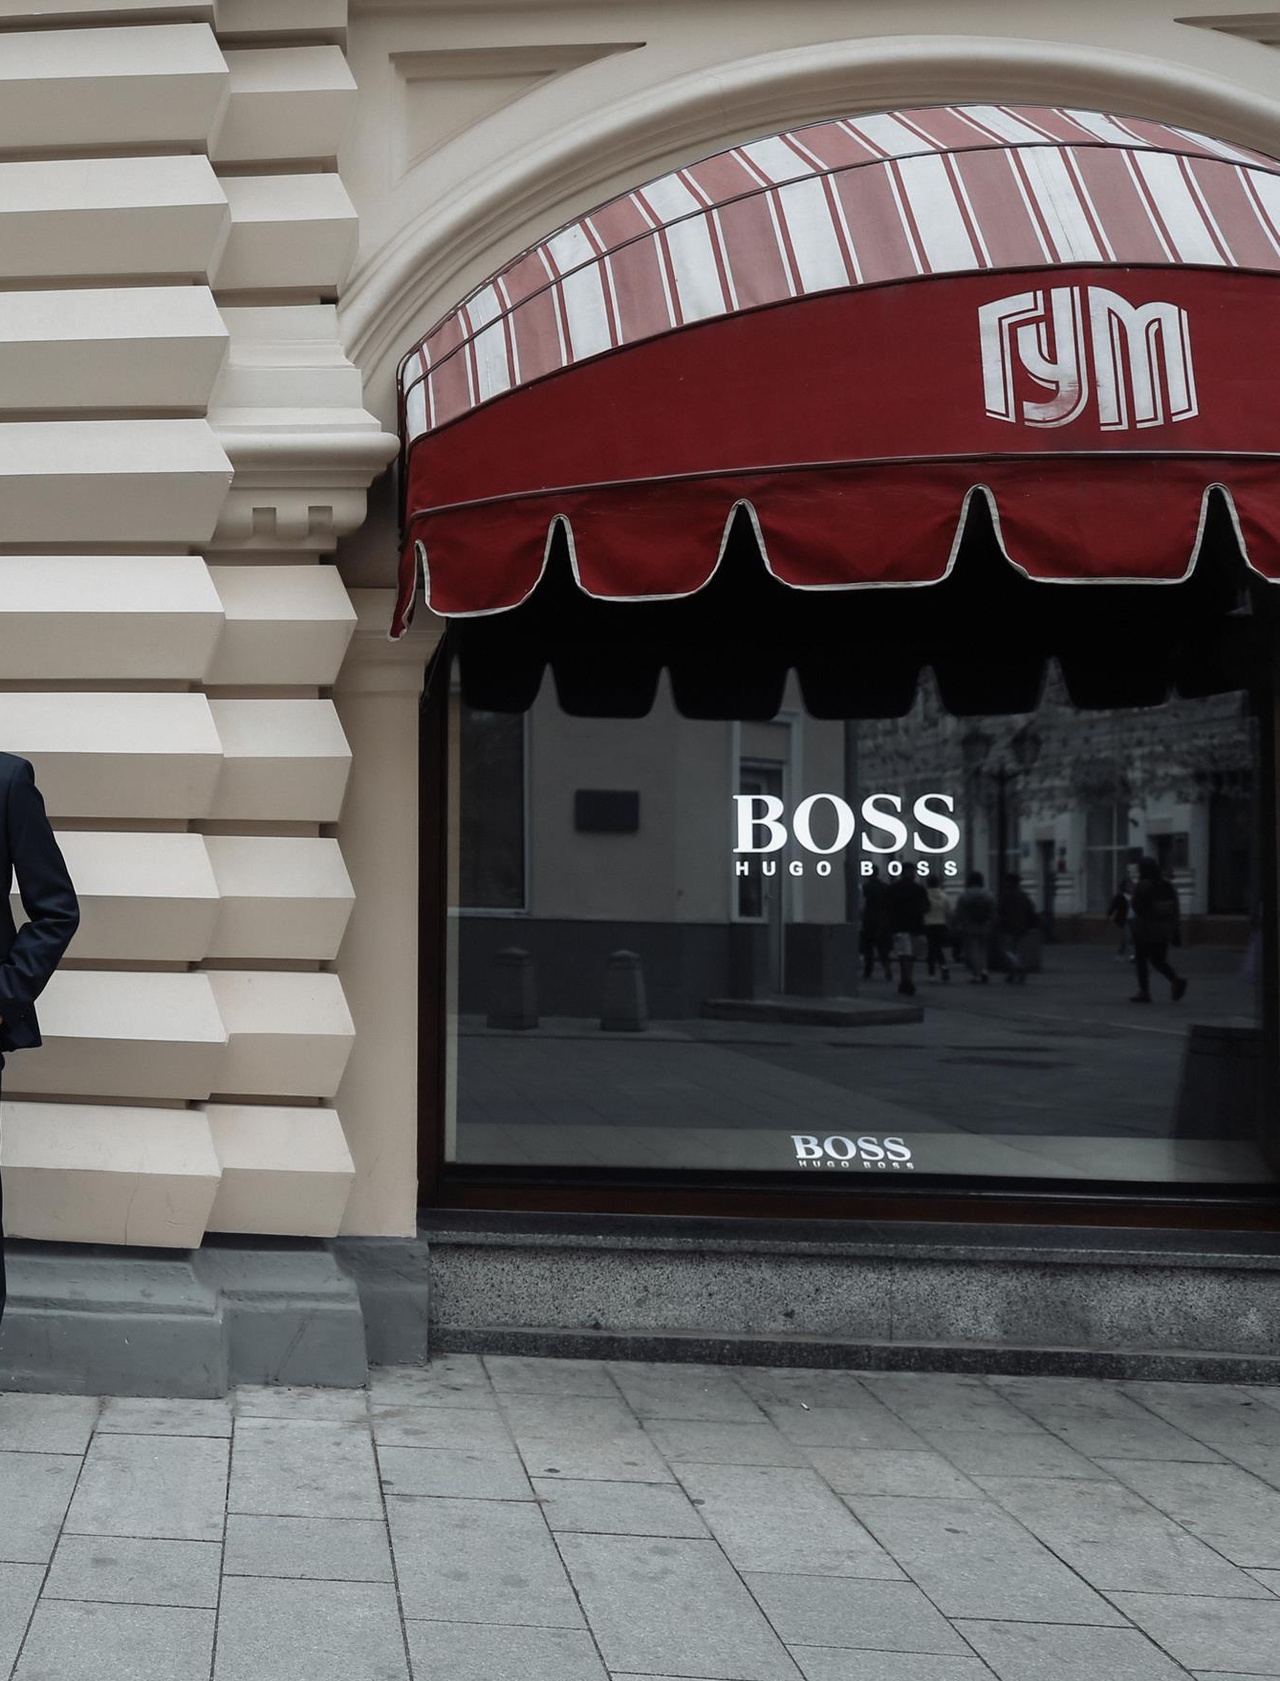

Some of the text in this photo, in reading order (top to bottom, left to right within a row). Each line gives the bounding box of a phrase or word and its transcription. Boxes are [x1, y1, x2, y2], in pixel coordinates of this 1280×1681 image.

[732, 793, 961, 855] BOSS
[735, 860, 958, 876] HUGO BOSS
[790, 1135, 912, 1161] BOSS
[798, 1160, 915, 1170] HUGO BOSS
